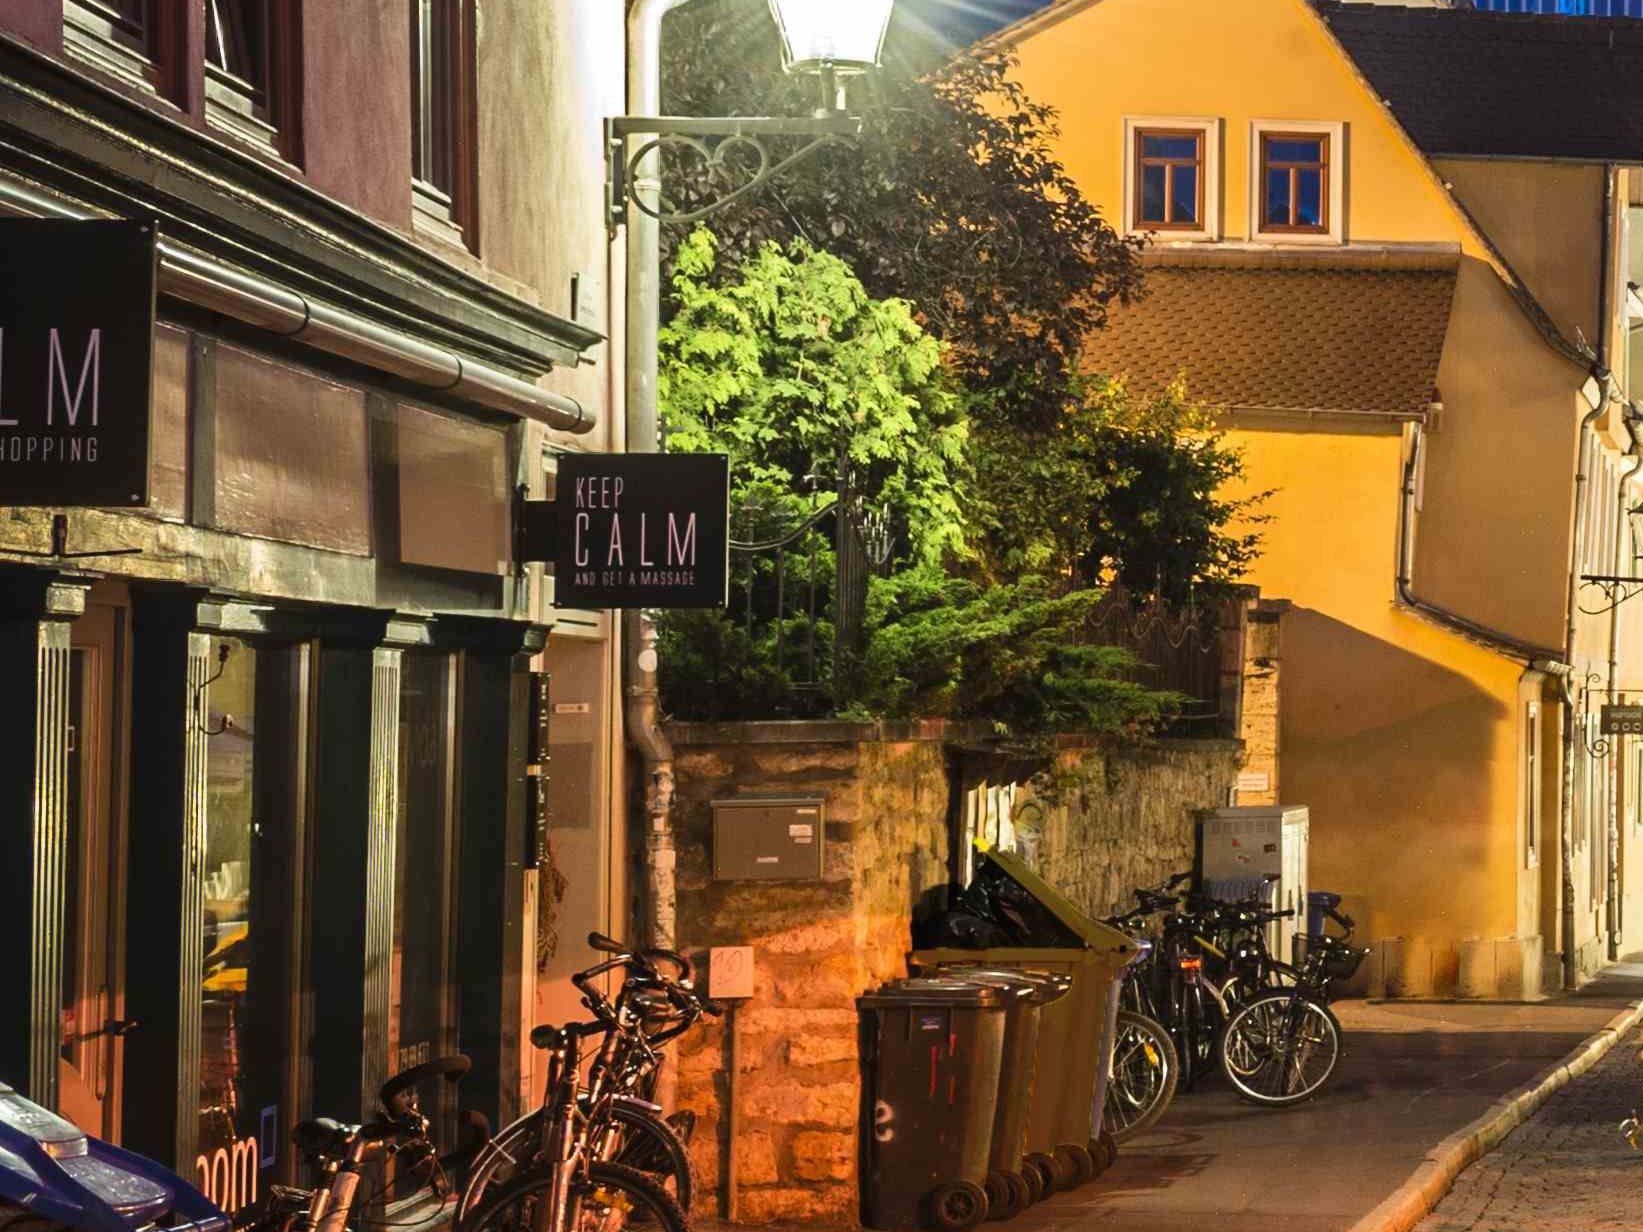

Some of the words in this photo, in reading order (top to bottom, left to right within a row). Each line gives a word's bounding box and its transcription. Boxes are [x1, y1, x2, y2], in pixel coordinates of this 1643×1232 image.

[575, 476, 624, 509] KEEP
[575, 512, 697, 567] CALM
[575, 571, 596, 586] AND
[602, 571, 622, 586] GET
[629, 571, 637, 586] A
[640, 570, 697, 586] MASSAGE
